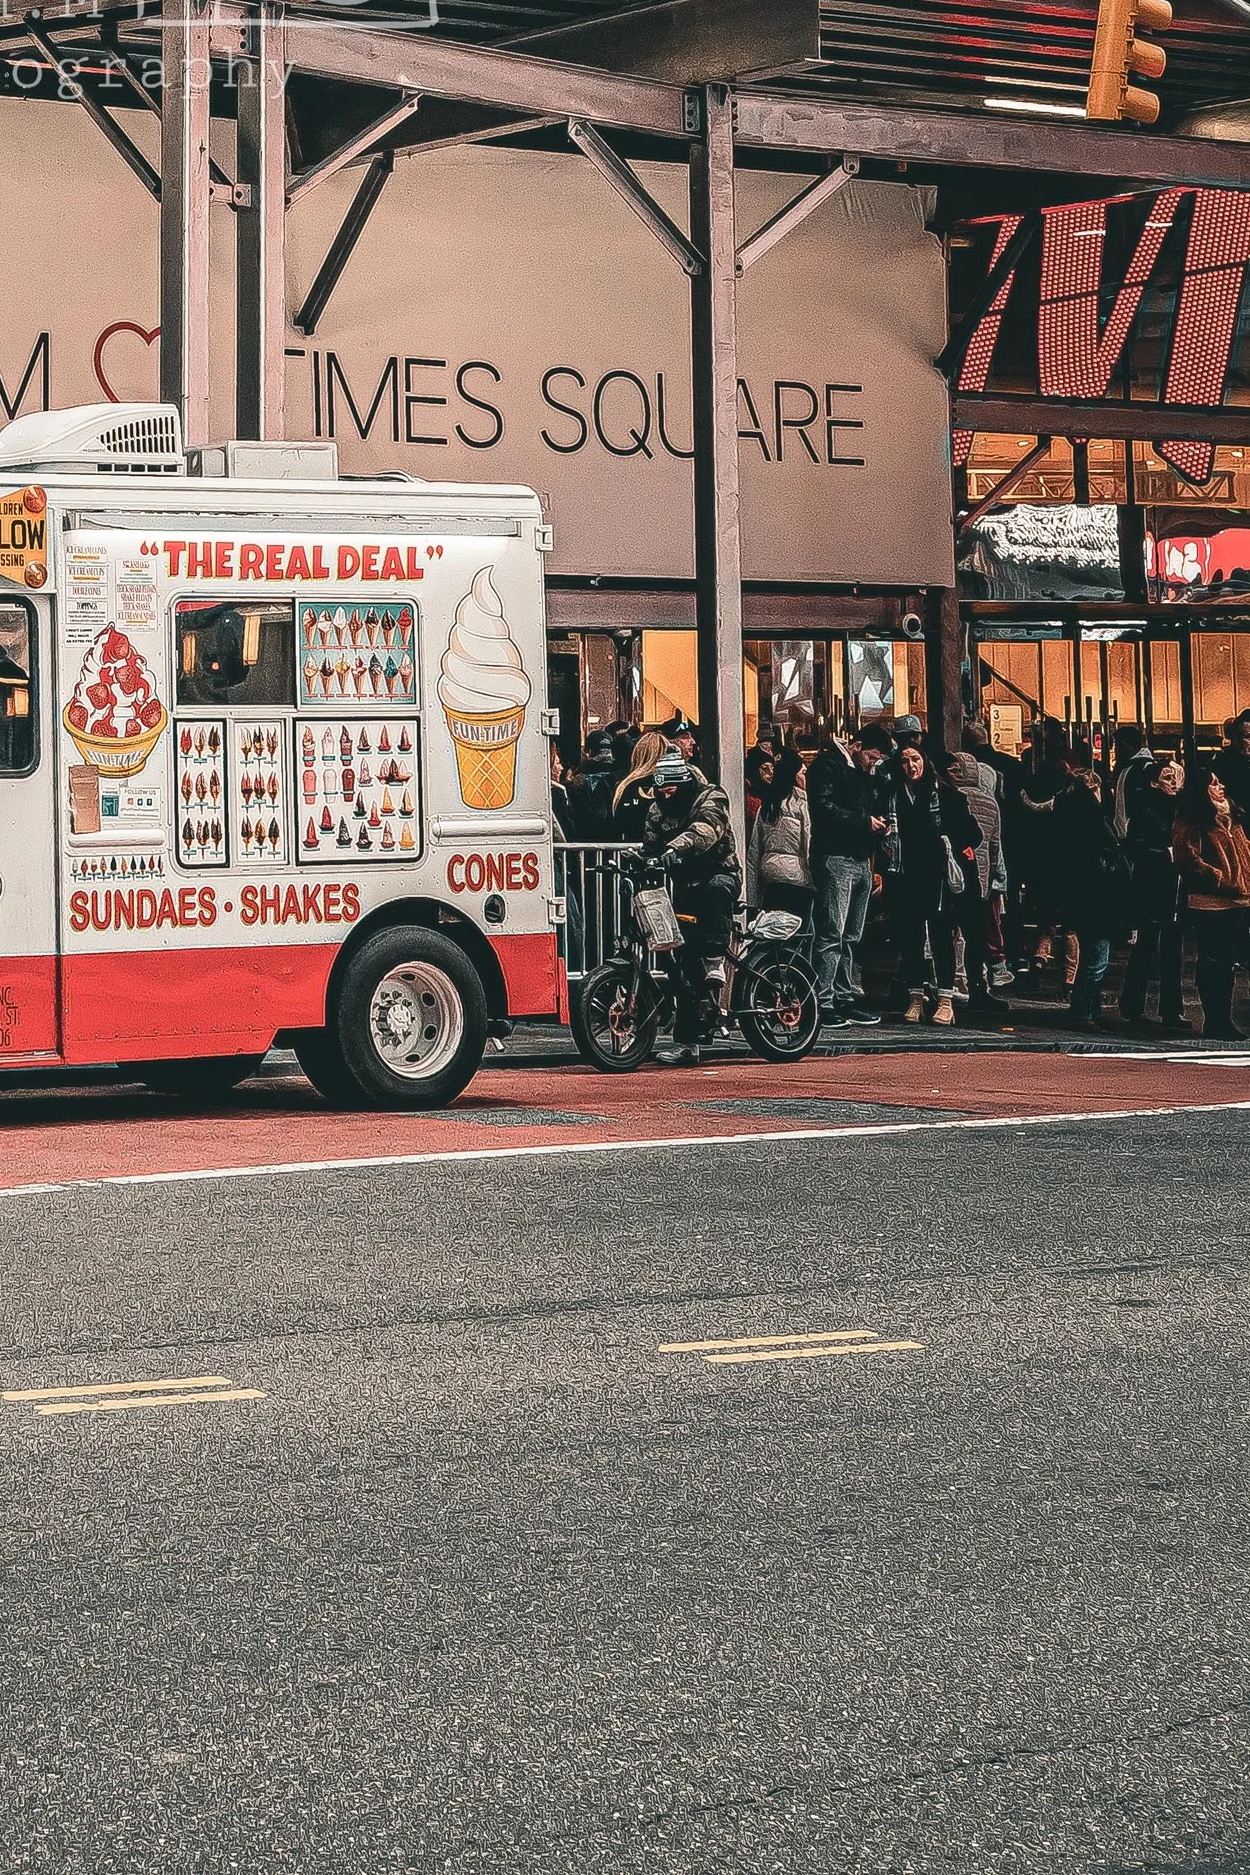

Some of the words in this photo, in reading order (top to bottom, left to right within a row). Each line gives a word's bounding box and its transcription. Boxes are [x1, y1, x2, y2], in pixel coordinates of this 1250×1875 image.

[239, 543, 330, 581] REAL
[993, 709, 1000, 720] 3
[993, 733, 1000, 744] 2
[447, 853, 540, 893] CONES
[70, 886, 217, 932] SUNDAES
[240, 883, 362, 926] SHAKES
